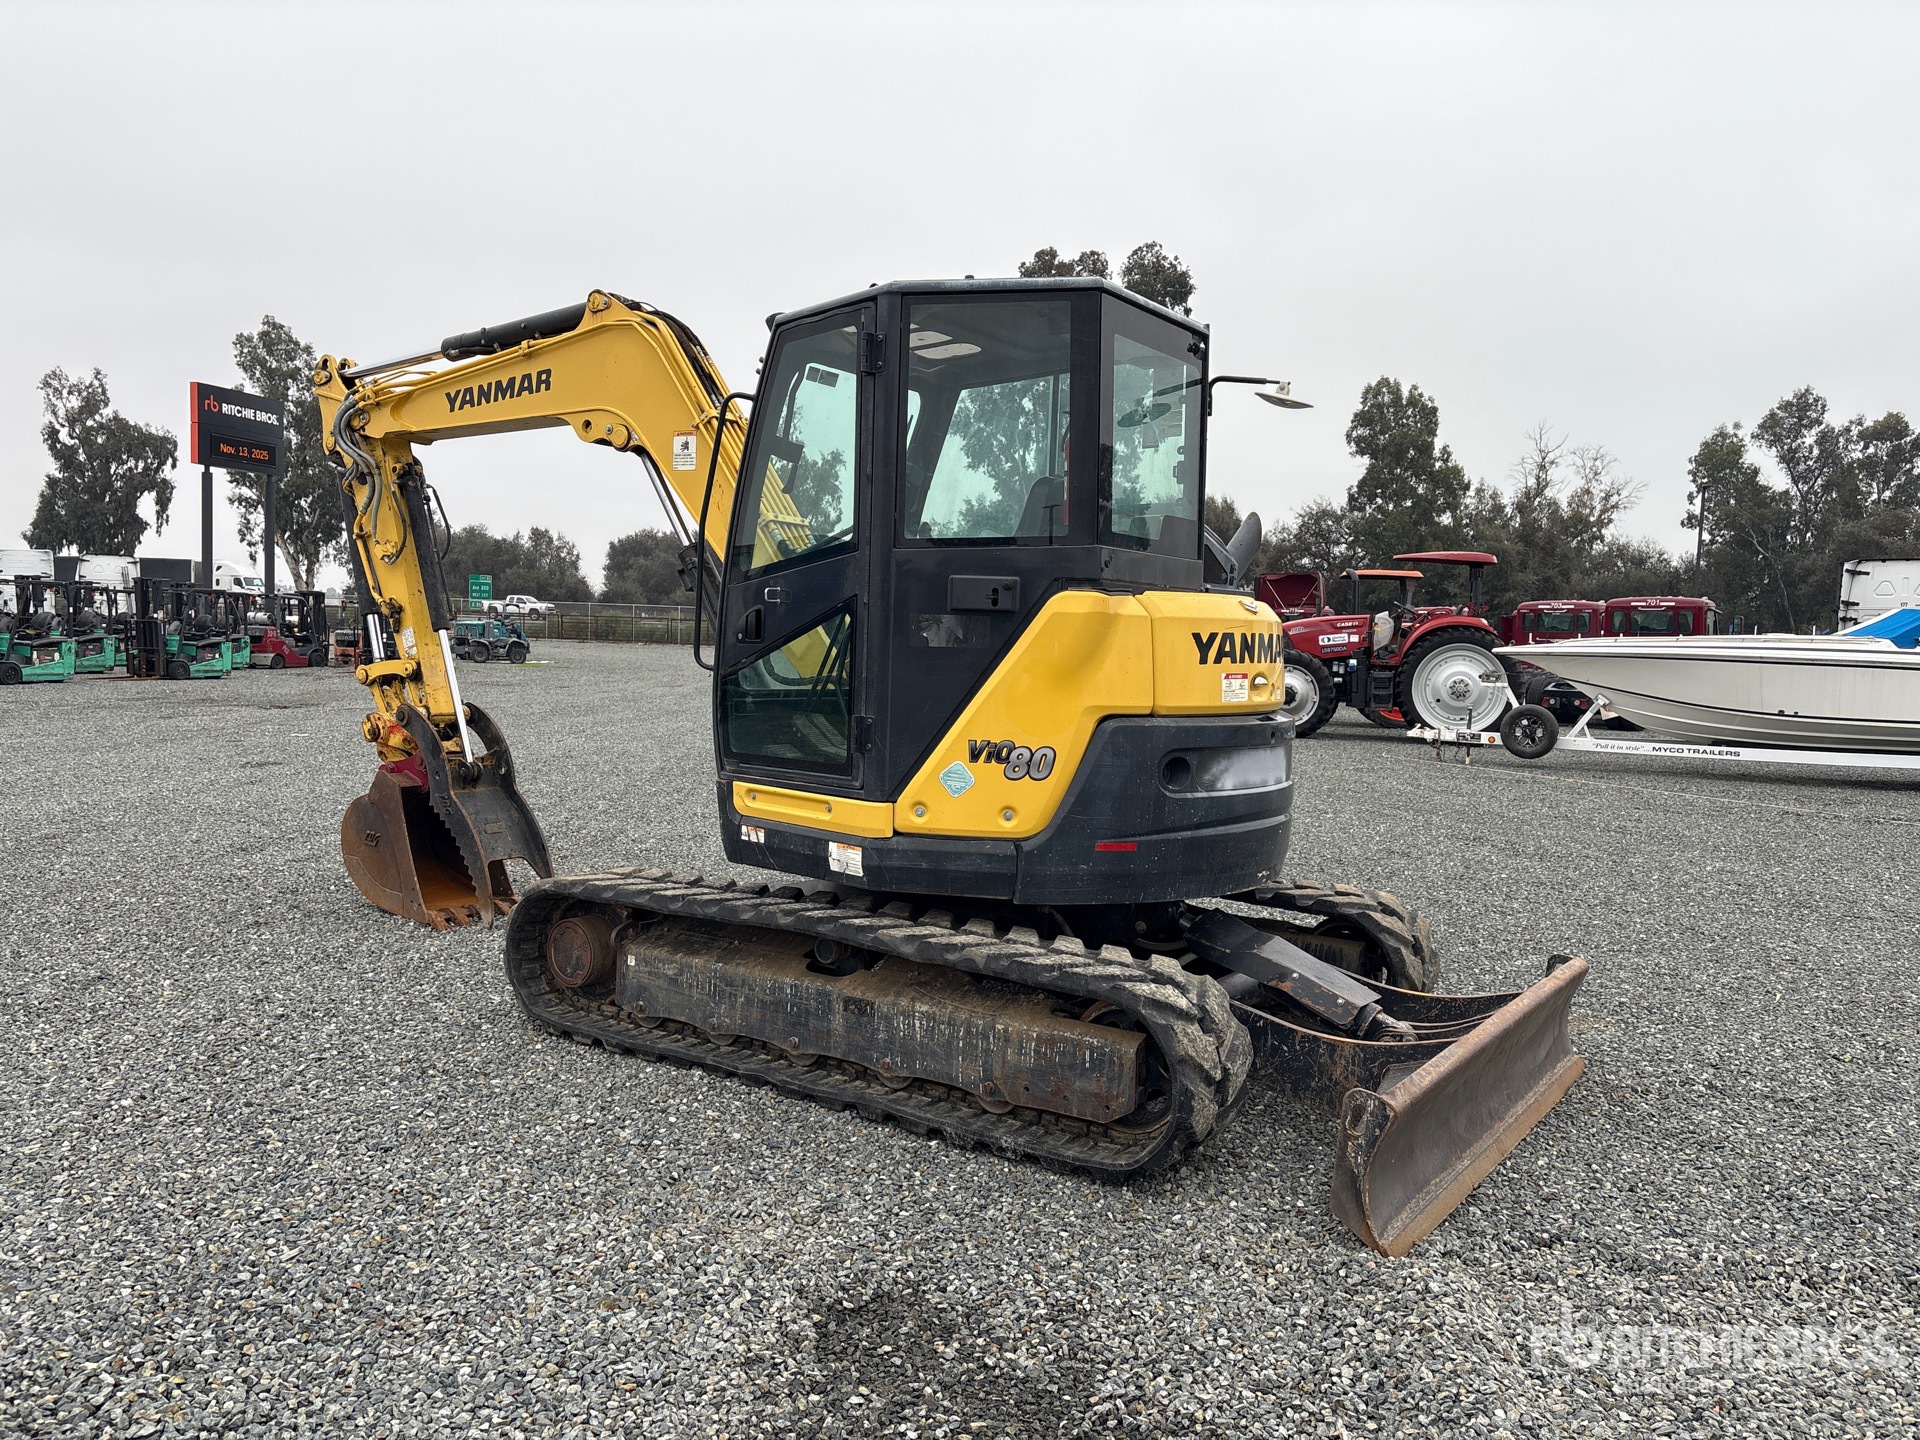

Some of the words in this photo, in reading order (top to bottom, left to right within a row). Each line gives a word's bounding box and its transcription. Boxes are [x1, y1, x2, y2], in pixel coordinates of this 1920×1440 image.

[444, 368, 552, 413] YANMAR
[204, 394, 219, 413] rb
[222, 403, 255, 420] RITCHIE
[256, 410, 279, 426] BROS.
[220, 443, 236, 455] Nov.
[239, 446, 249, 458] 13,
[251, 448, 269, 460] 2025
[1191, 632, 1283, 664] YANMA
[1652, 746, 1684, 754] MYCO
[1686, 748, 1741, 757] TRAILERS
